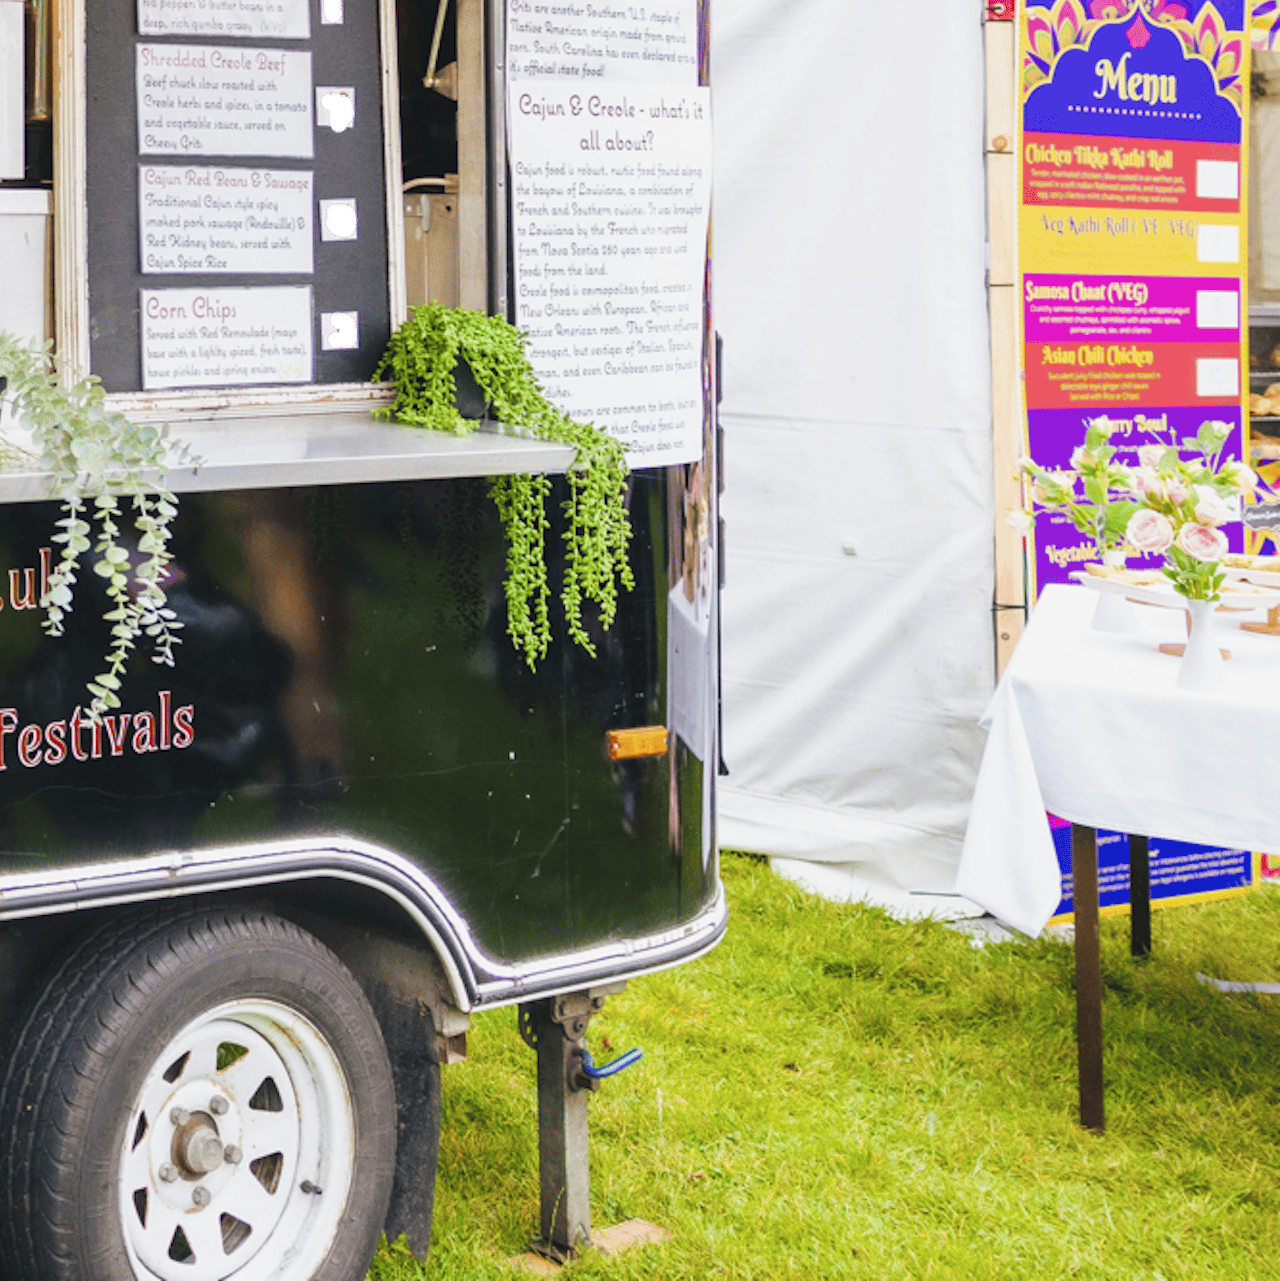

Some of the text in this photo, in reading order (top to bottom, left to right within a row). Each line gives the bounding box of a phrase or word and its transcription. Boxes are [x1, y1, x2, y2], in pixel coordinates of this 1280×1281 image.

[141, 49, 286, 75] Shredded Creole Beef
[143, 76, 277, 92] Beef chuck slow roasted with
[1093, 51, 1177, 105] Menu
[144, 95, 175, 108] Creole
[177, 96, 201, 109] herbs
[204, 99, 222, 110] and
[225, 101, 251, 113] spices,
[254, 101, 264, 111] in
[274, 101, 307, 113] tomato
[519, 93, 565, 120] Cajun
[570, 95, 583, 115] &
[589, 95, 635, 117] Creole
[650, 99, 689, 120] what's
[694, 103, 703, 119] it
[145, 118, 285, 133] and vegetable sauce, served on
[145, 136, 202, 150] Cheesy Grits
[580, 130, 654, 151] all about?
[1026, 143, 1174, 172] Chicken Tikka Kathi Roll
[145, 169, 308, 192] Cajun Red Beans & Sausage
[146, 193, 278, 212] Traditional Cajun style spicy
[1042, 214, 1064, 236] Veg
[1068, 215, 1100, 235] Kathi
[1104, 216, 1129, 237] Roll
[147, 236, 291, 252] Red Kidney beans, served with
[147, 255, 226, 271] Cajun Spice Rice
[1026, 280, 1148, 306] Samosa Chaat (VEG)
[147, 297, 236, 322] Corn Chips
[1041, 345, 1076, 365] Asian
[1107, 345, 1154, 367] Chicken
